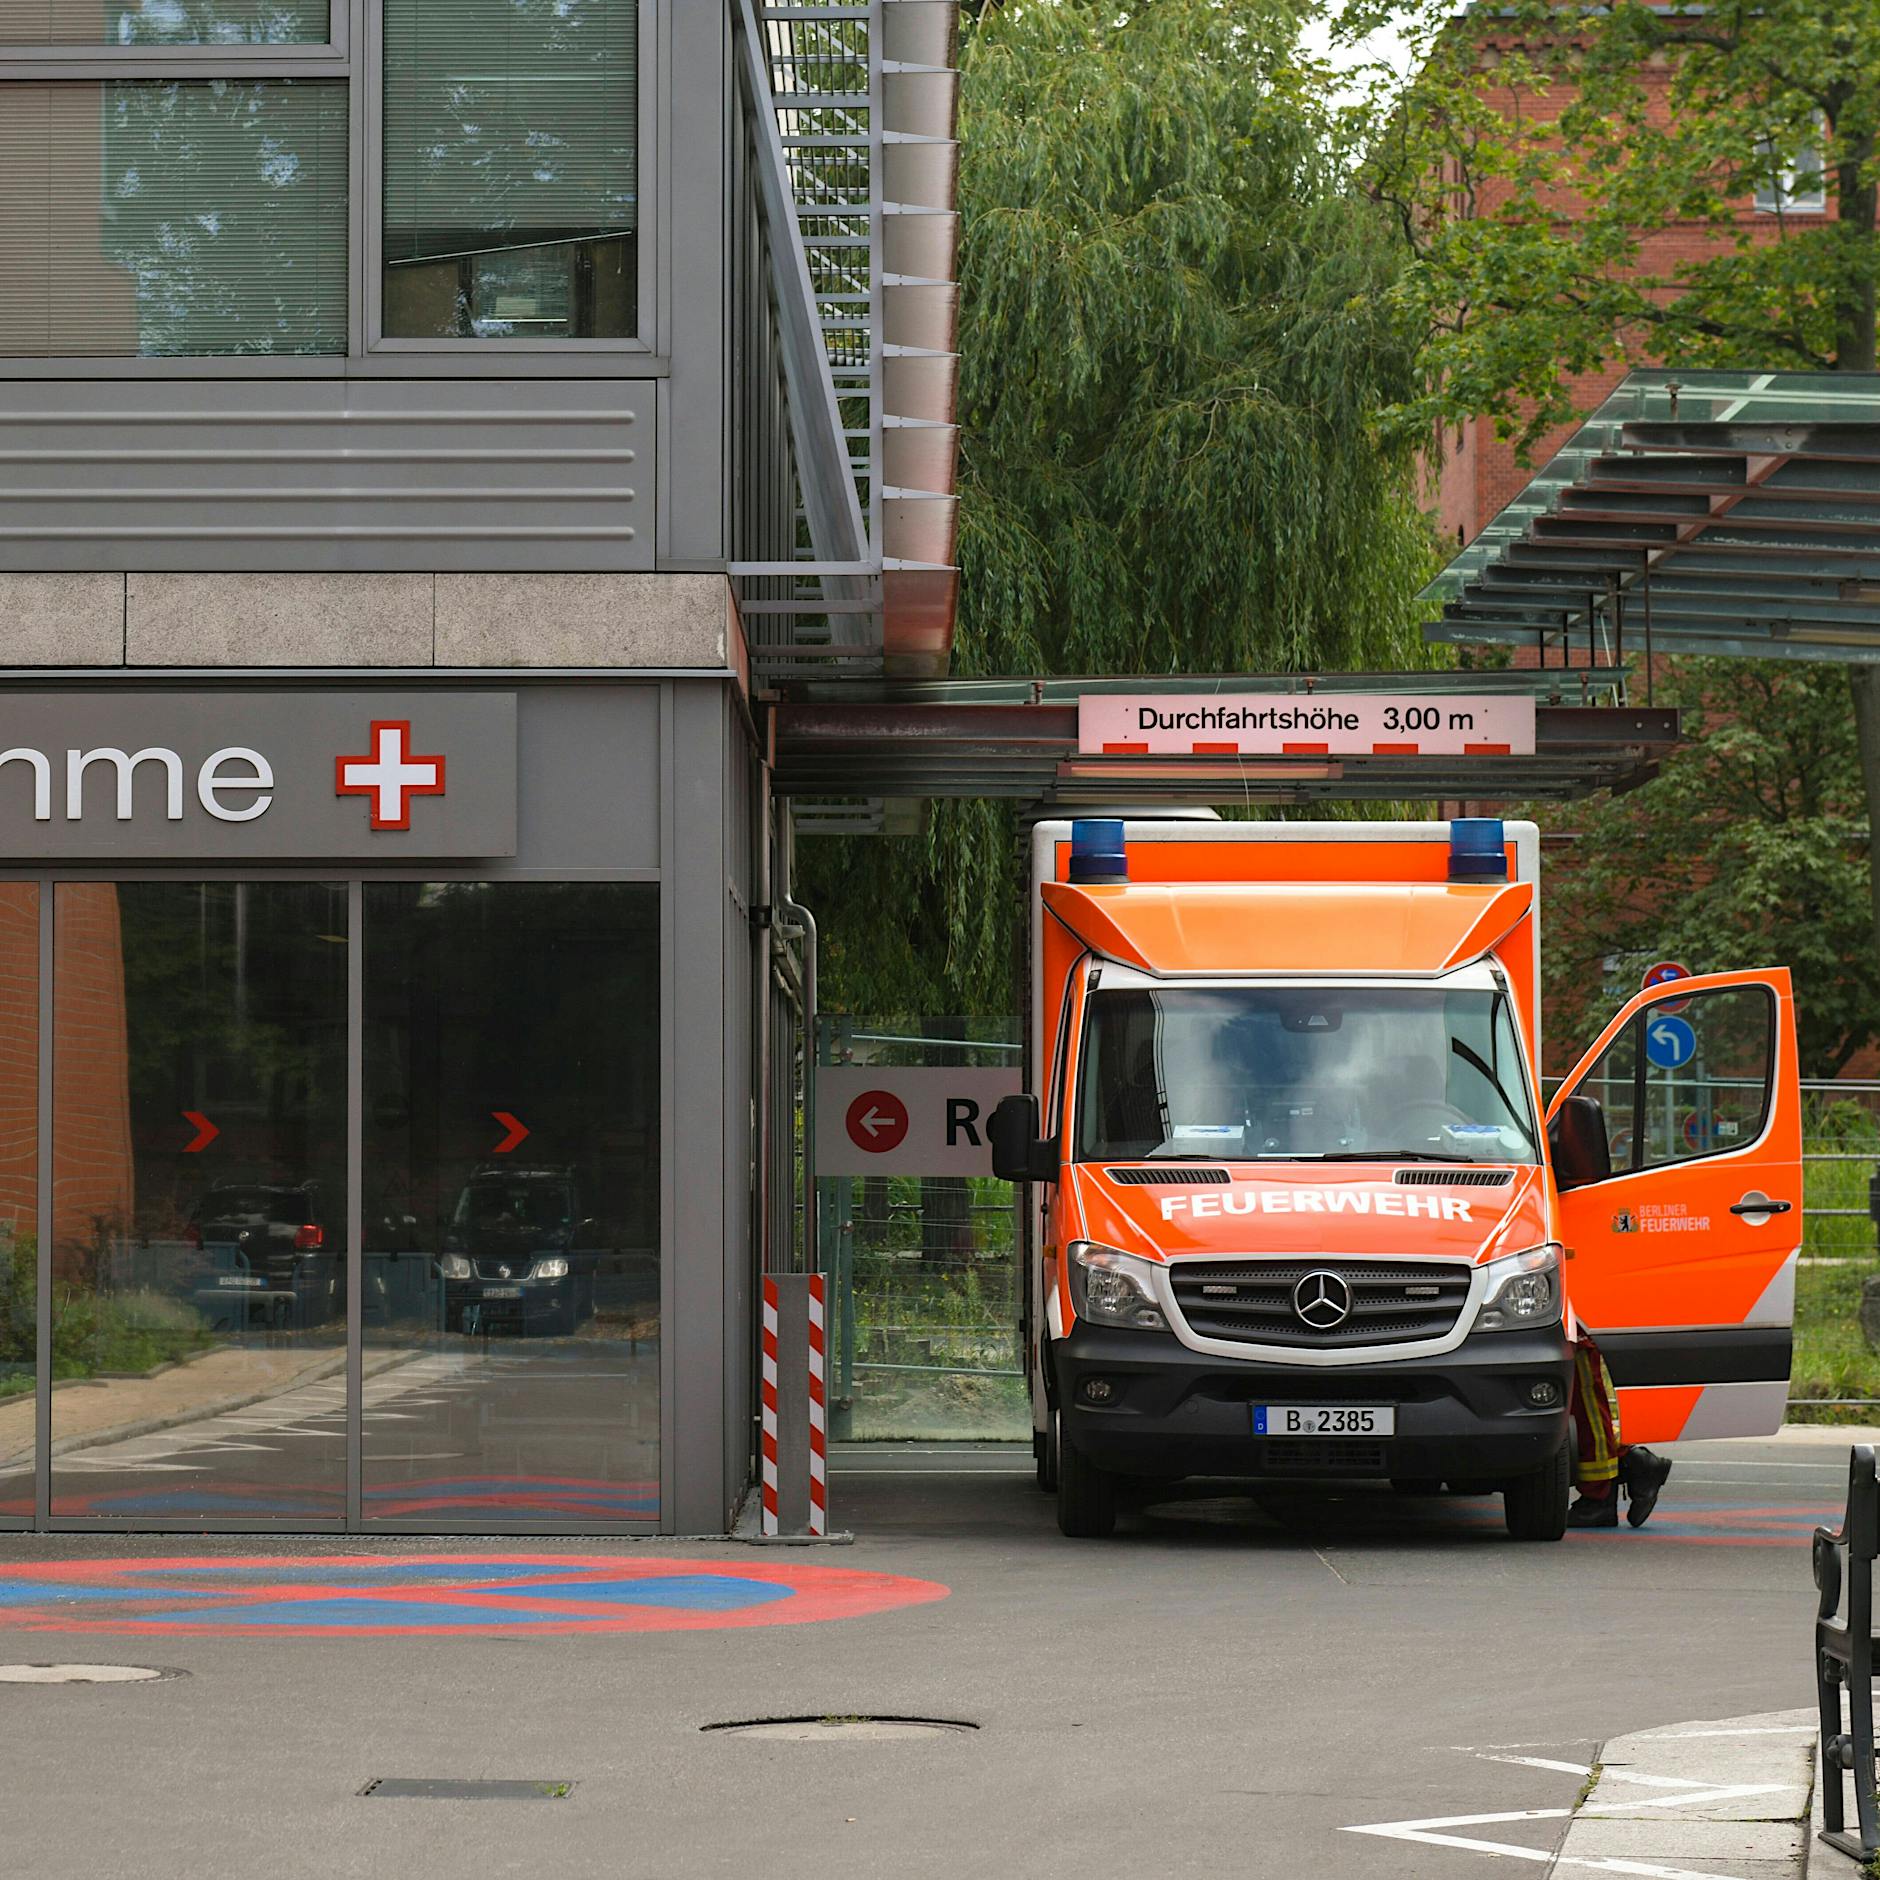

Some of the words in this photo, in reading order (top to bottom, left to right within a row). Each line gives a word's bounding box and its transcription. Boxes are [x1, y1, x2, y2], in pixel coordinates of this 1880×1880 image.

[1138, 705, 1360, 731] Durchfahrtshöhe
[1383, 706, 1441, 734] 3,00
[1449, 712, 1474, 730] m
[1160, 1190, 1473, 1222] FEUERWEHR
[1639, 1203, 1687, 1217] BERLINER
[1640, 1216, 1710, 1232] FEUERWEHR
[1286, 1409, 1302, 1432] B
[1317, 1409, 1375, 1432] 2385
